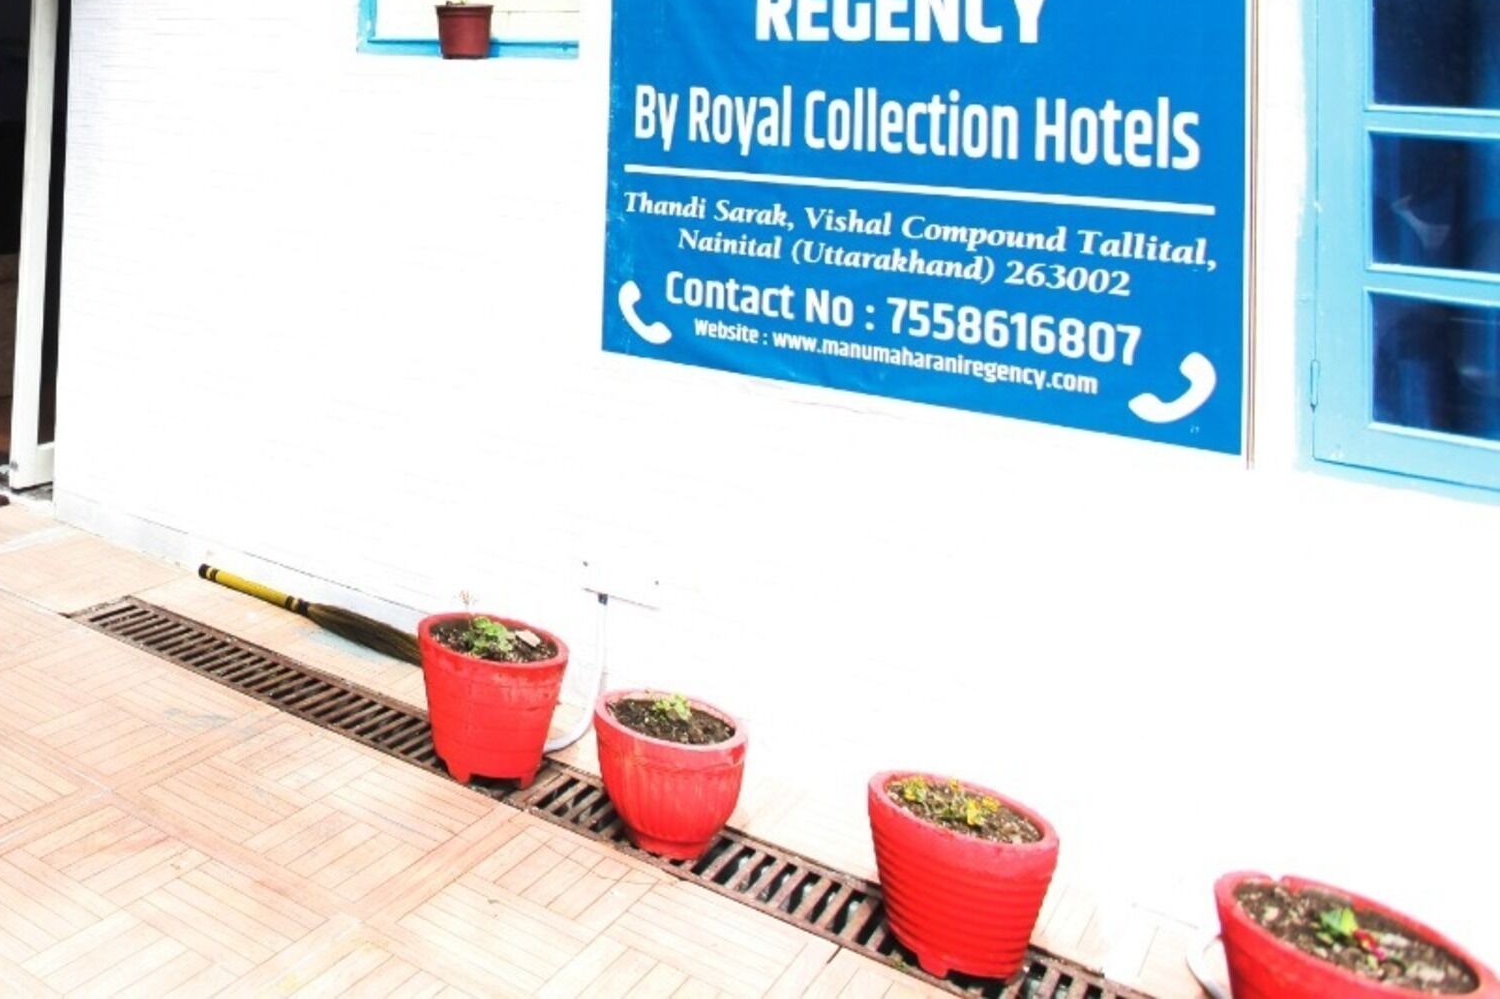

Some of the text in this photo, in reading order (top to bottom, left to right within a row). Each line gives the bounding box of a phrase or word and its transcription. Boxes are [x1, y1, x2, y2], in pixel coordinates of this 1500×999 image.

[634, 85, 1201, 171] By Royal Collection Hotels
[623, 192, 1218, 271] Thandi Sarak, Vishal Compound Tallital,
[678, 228, 1131, 296] Nainital (Uttarakhand) 263002
[665, 271, 1142, 366] Contact No : 7558616807
[693, 317, 759, 345] Website
[773, 329, 1098, 394] www.manumaharaniregency.com
